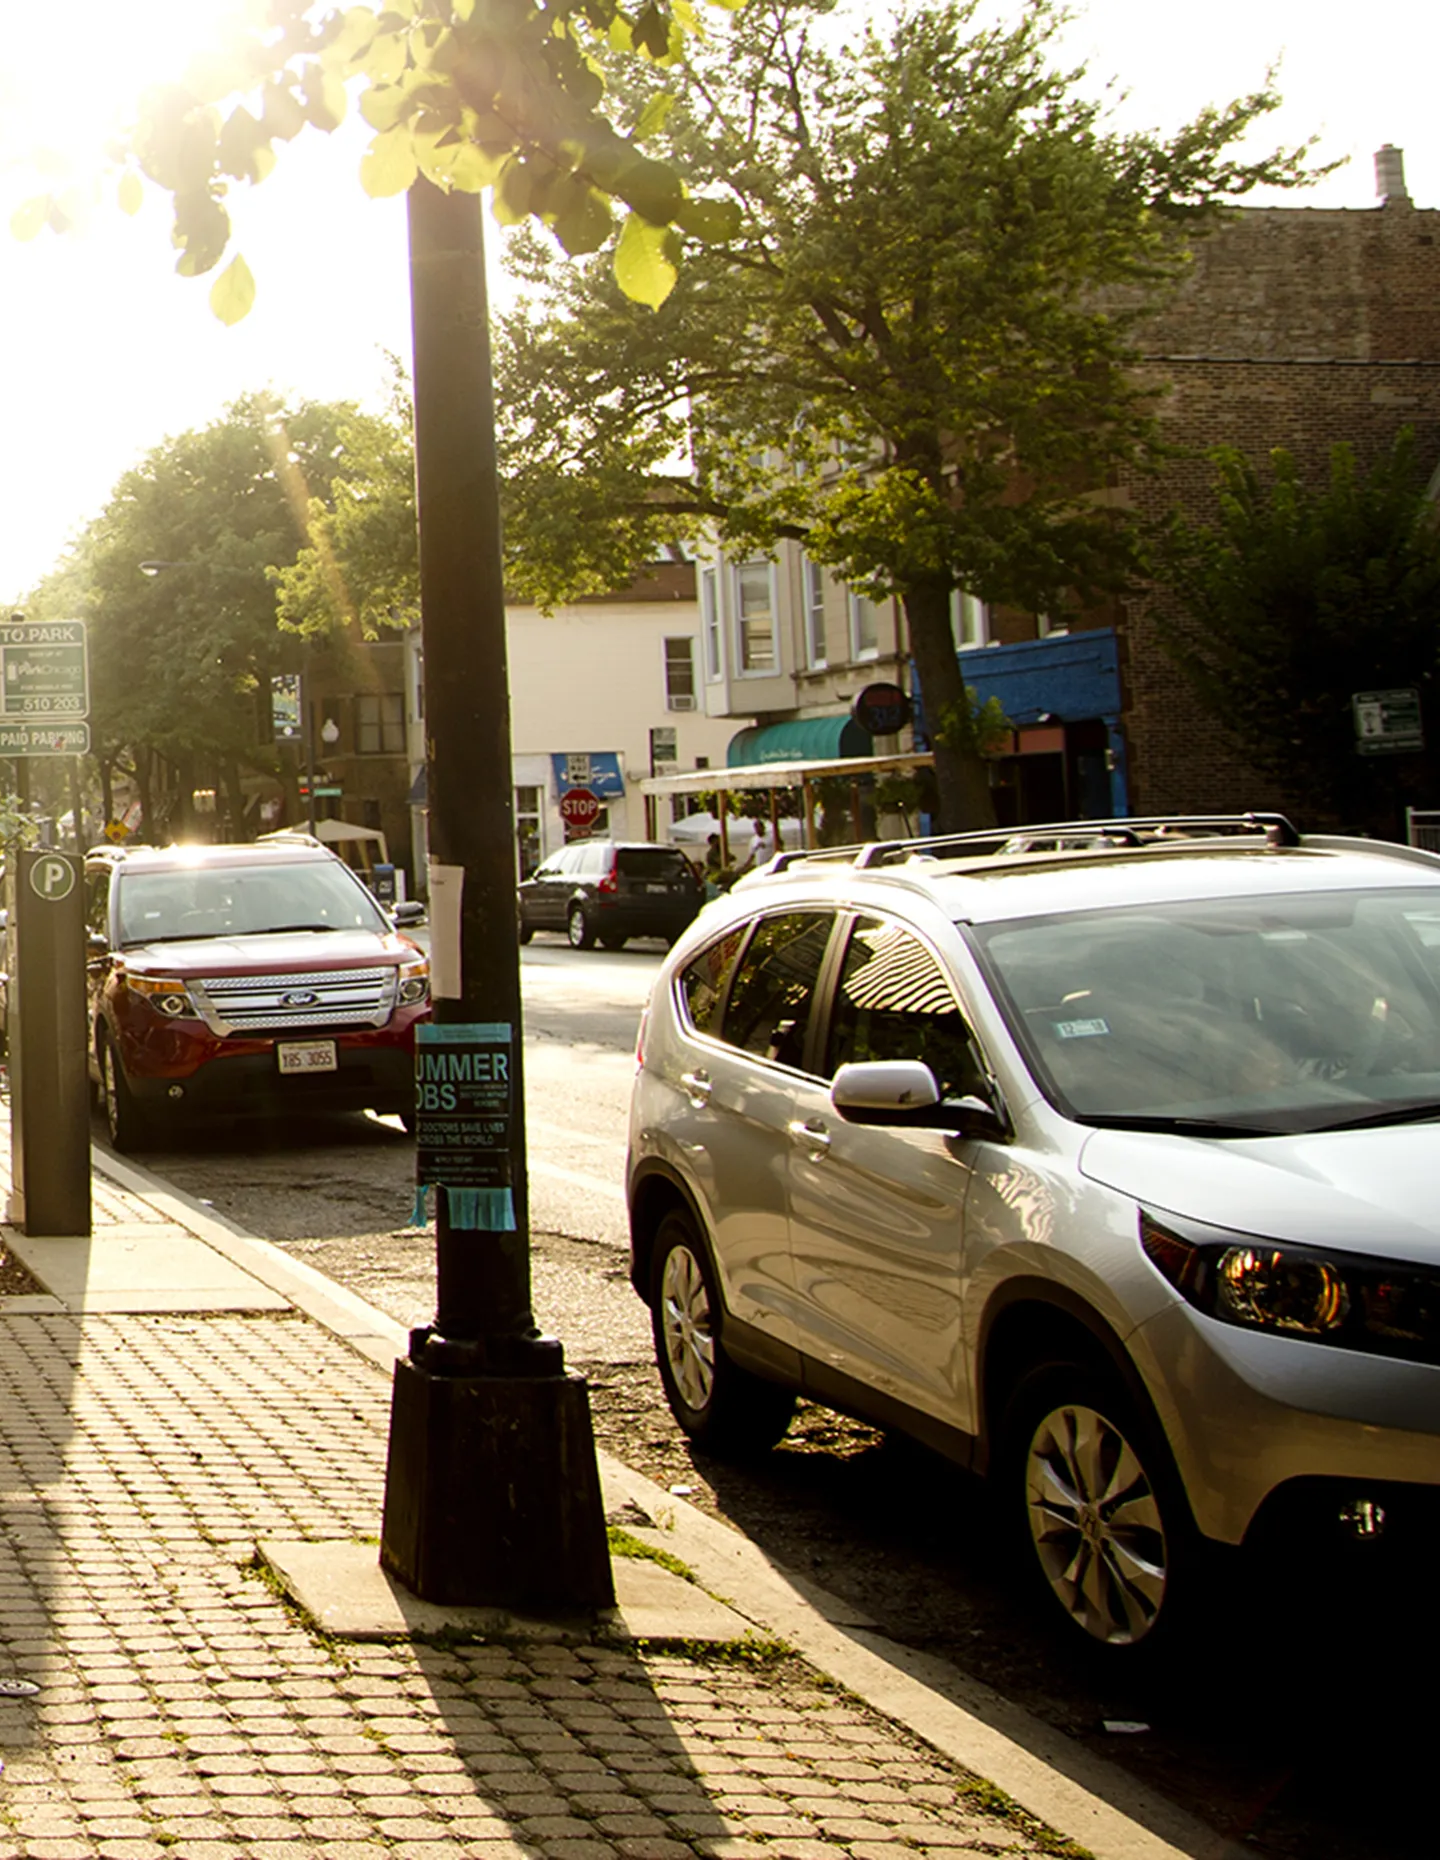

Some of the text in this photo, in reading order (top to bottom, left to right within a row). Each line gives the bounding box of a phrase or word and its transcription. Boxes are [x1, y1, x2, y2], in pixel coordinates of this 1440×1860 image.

[1, 629, 25, 643] TO
[28, 626, 76, 642] PARK
[23, 698, 51, 712] 510
[53, 697, 81, 711] 203
[0, 732, 29, 747] PAID
[31, 730, 86, 746] PARKING
[562, 799, 598, 816] STOP
[42, 863, 66, 893] P
